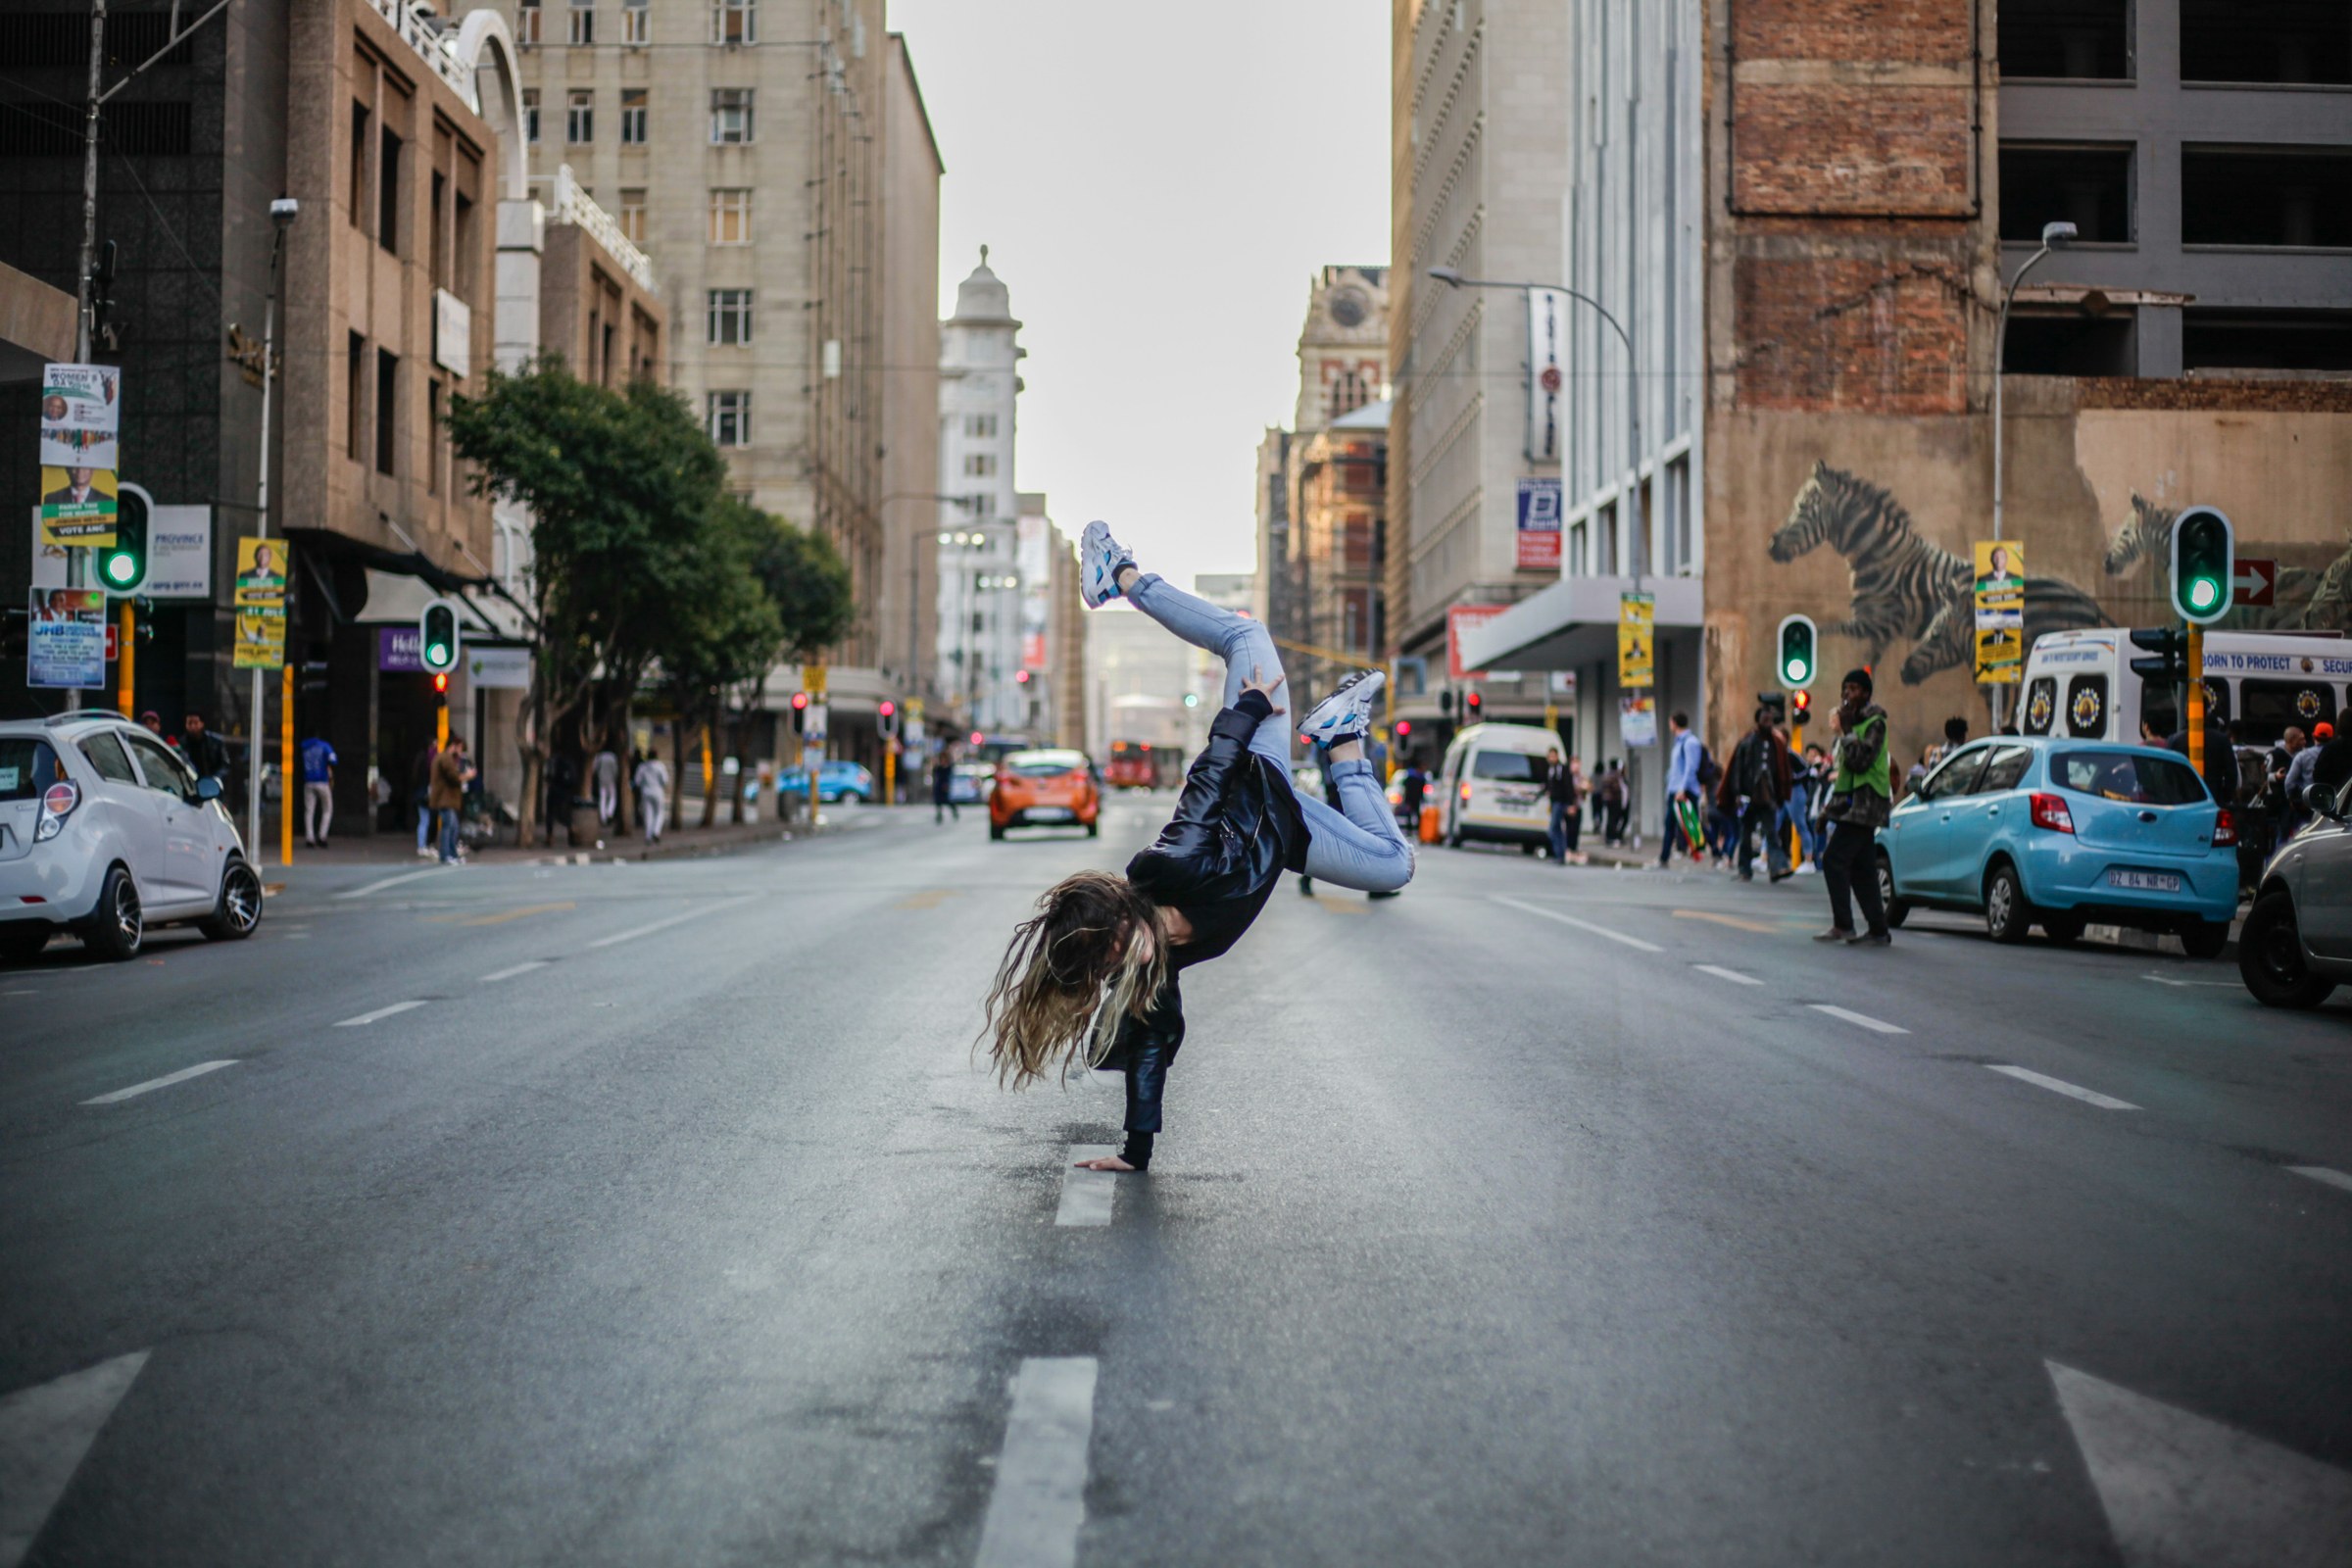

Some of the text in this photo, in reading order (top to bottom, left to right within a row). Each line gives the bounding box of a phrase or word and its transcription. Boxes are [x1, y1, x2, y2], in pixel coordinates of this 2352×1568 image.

[155, 533, 203, 543] PROVINCE
[35, 624, 65, 636] JHB
[392, 634, 420, 653] Hell
[2203, 654, 2228, 667] BORN
[2230, 655, 2243, 668] TO
[2247, 656, 2290, 670] PROTECT
[2166, 875, 2180, 890] GP
